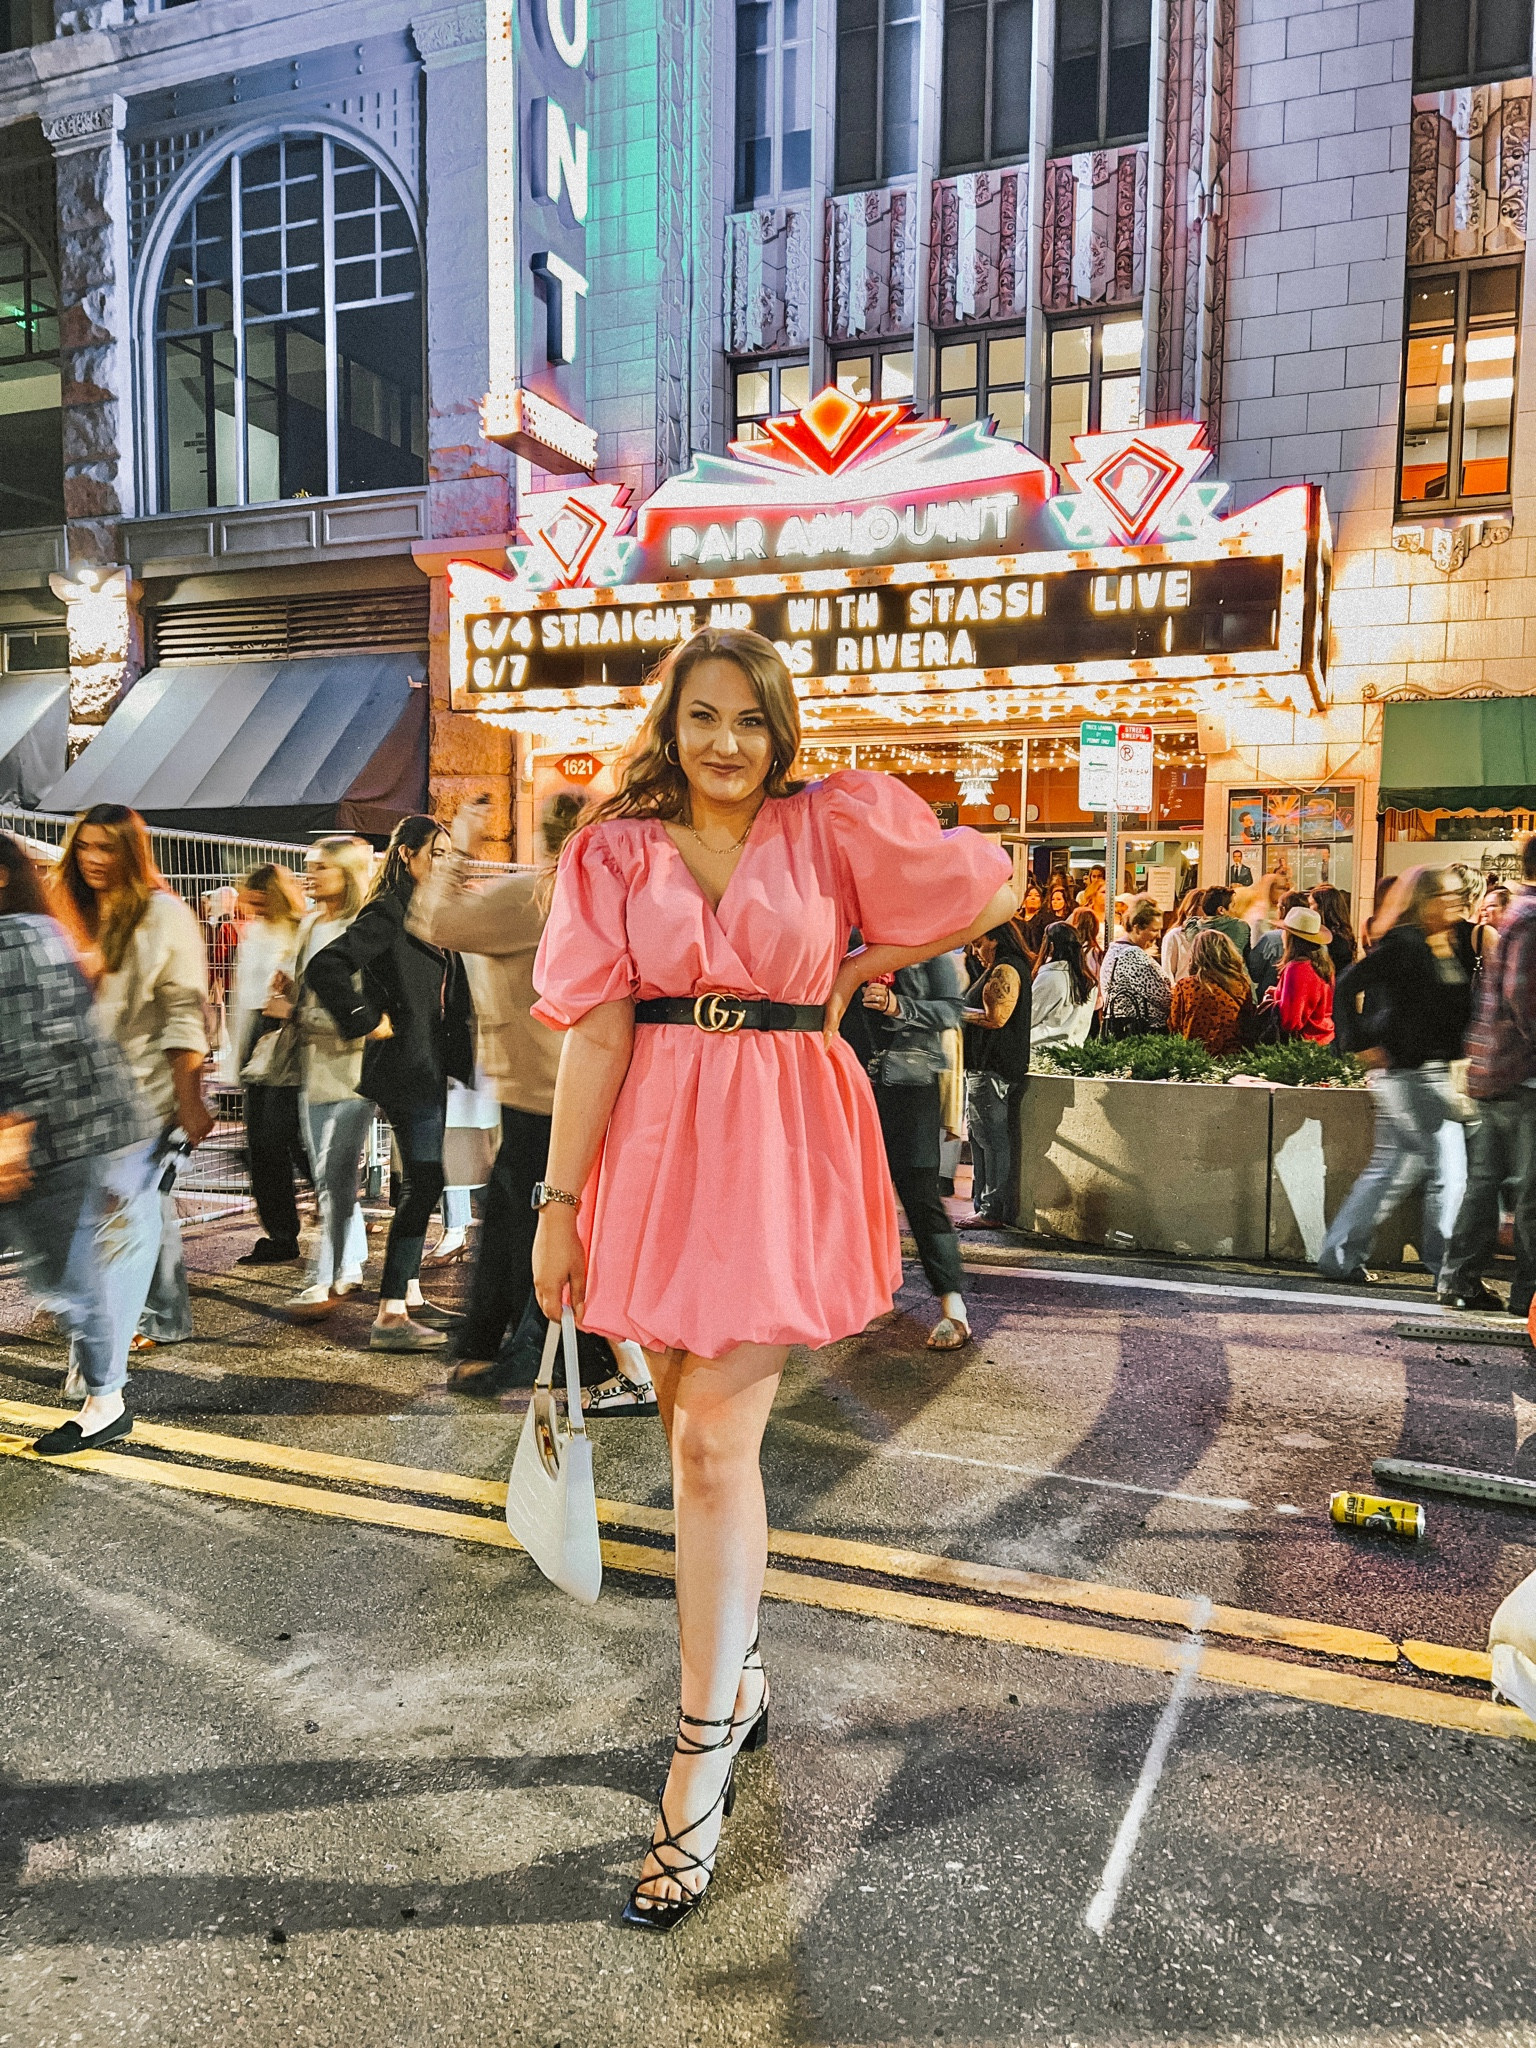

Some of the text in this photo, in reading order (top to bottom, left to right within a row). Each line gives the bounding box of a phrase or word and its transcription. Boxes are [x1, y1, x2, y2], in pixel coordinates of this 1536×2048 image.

[473, 616, 533, 650] 6/4
[541, 606, 696, 649] STRAIGHT
[787, 592, 879, 633] WITH
[909, 581, 1044, 624] STASSI
[1094, 570, 1189, 611] LIVE
[473, 654, 528, 688] 6/7
[836, 629, 975, 670] RIVERA
[563, 760, 593, 775] 1621
